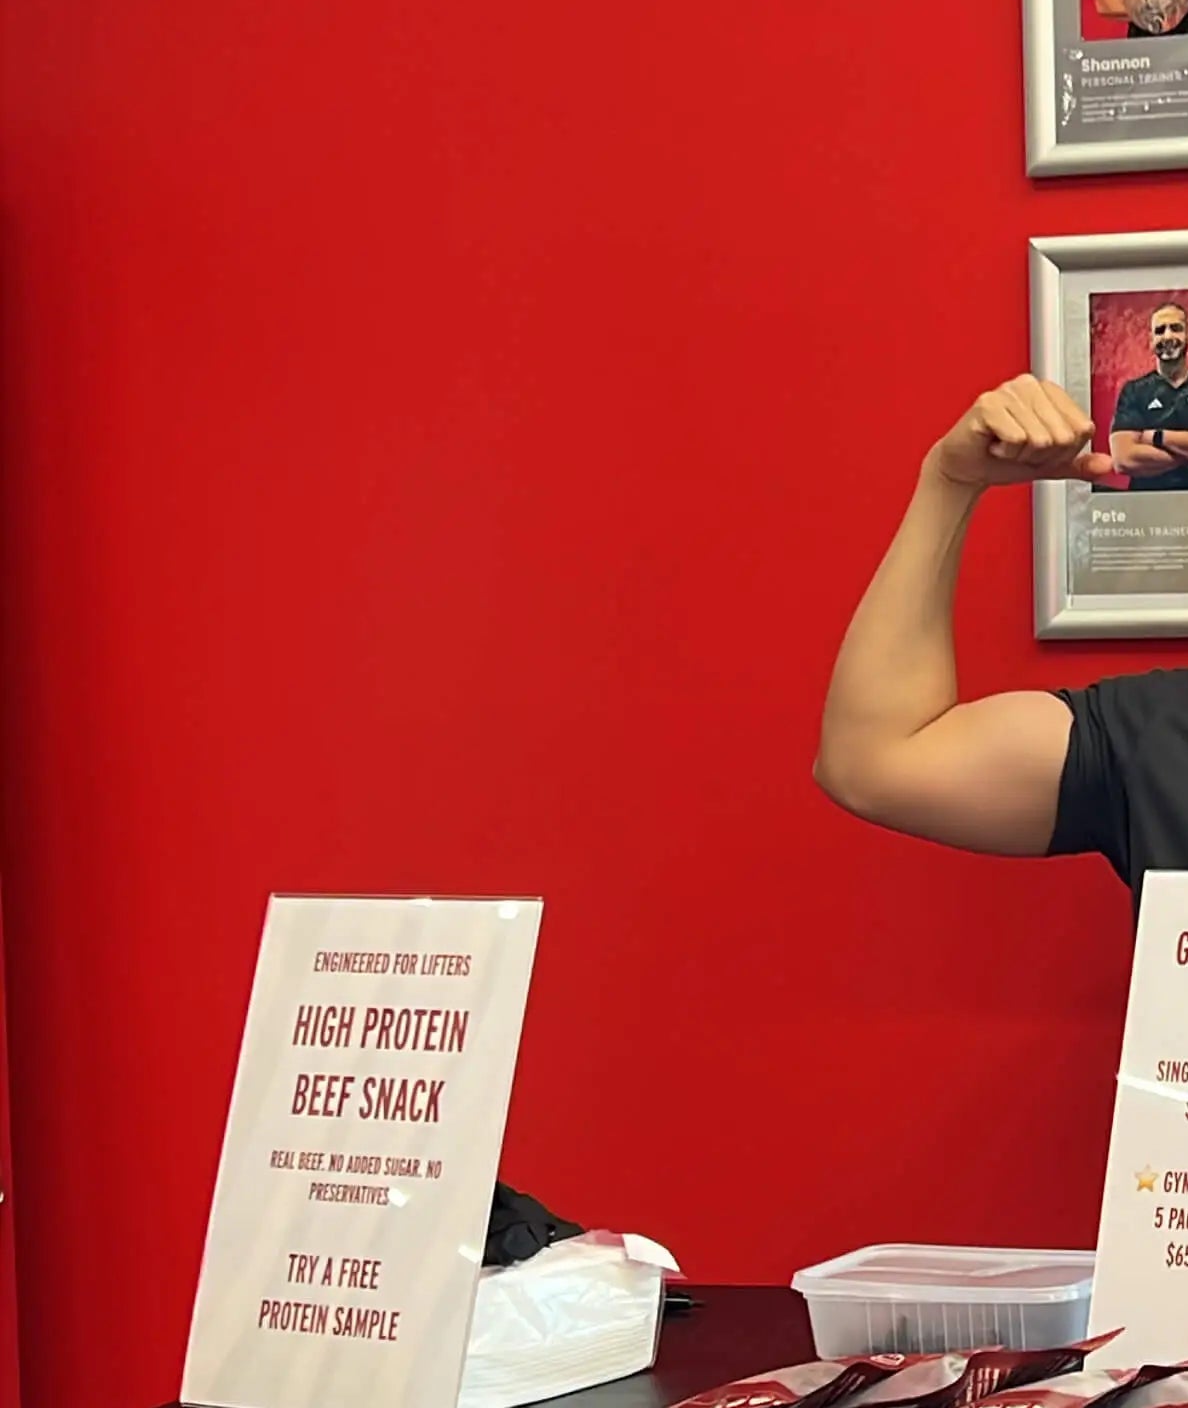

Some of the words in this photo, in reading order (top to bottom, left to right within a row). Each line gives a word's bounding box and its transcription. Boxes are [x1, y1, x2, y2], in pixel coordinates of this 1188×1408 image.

[1081, 57, 1151, 72] Shannon
[1081, 75, 1134, 88] PERSONAL
[1092, 510, 1126, 523] Pete
[1090, 527, 1146, 538] PERSONAL
[313, 951, 391, 974] ENGINEERED
[392, 953, 418, 975] FOR
[420, 954, 472, 976] LIFTERS
[292, 1005, 356, 1048] HIGH
[360, 1007, 469, 1053] PROTEIN
[291, 1074, 355, 1118] BEEF
[359, 1076, 446, 1123] SNACK
[270, 1150, 295, 1170] REAL
[298, 1152, 326, 1171] BEEF.
[328, 1154, 344, 1172] NO
[345, 1155, 382, 1175] ADDED
[384, 1157, 422, 1178] SUGAR.
[425, 1160, 442, 1179] NO
[308, 1182, 390, 1206] PRESERVATIVES
[1154, 1207, 1164, 1229] 5
[287, 1253, 320, 1285] TRY
[321, 1256, 333, 1287] A
[338, 1258, 382, 1290] FREE
[258, 1299, 329, 1335] PROTEIN
[332, 1306, 400, 1341] SAMPLE
